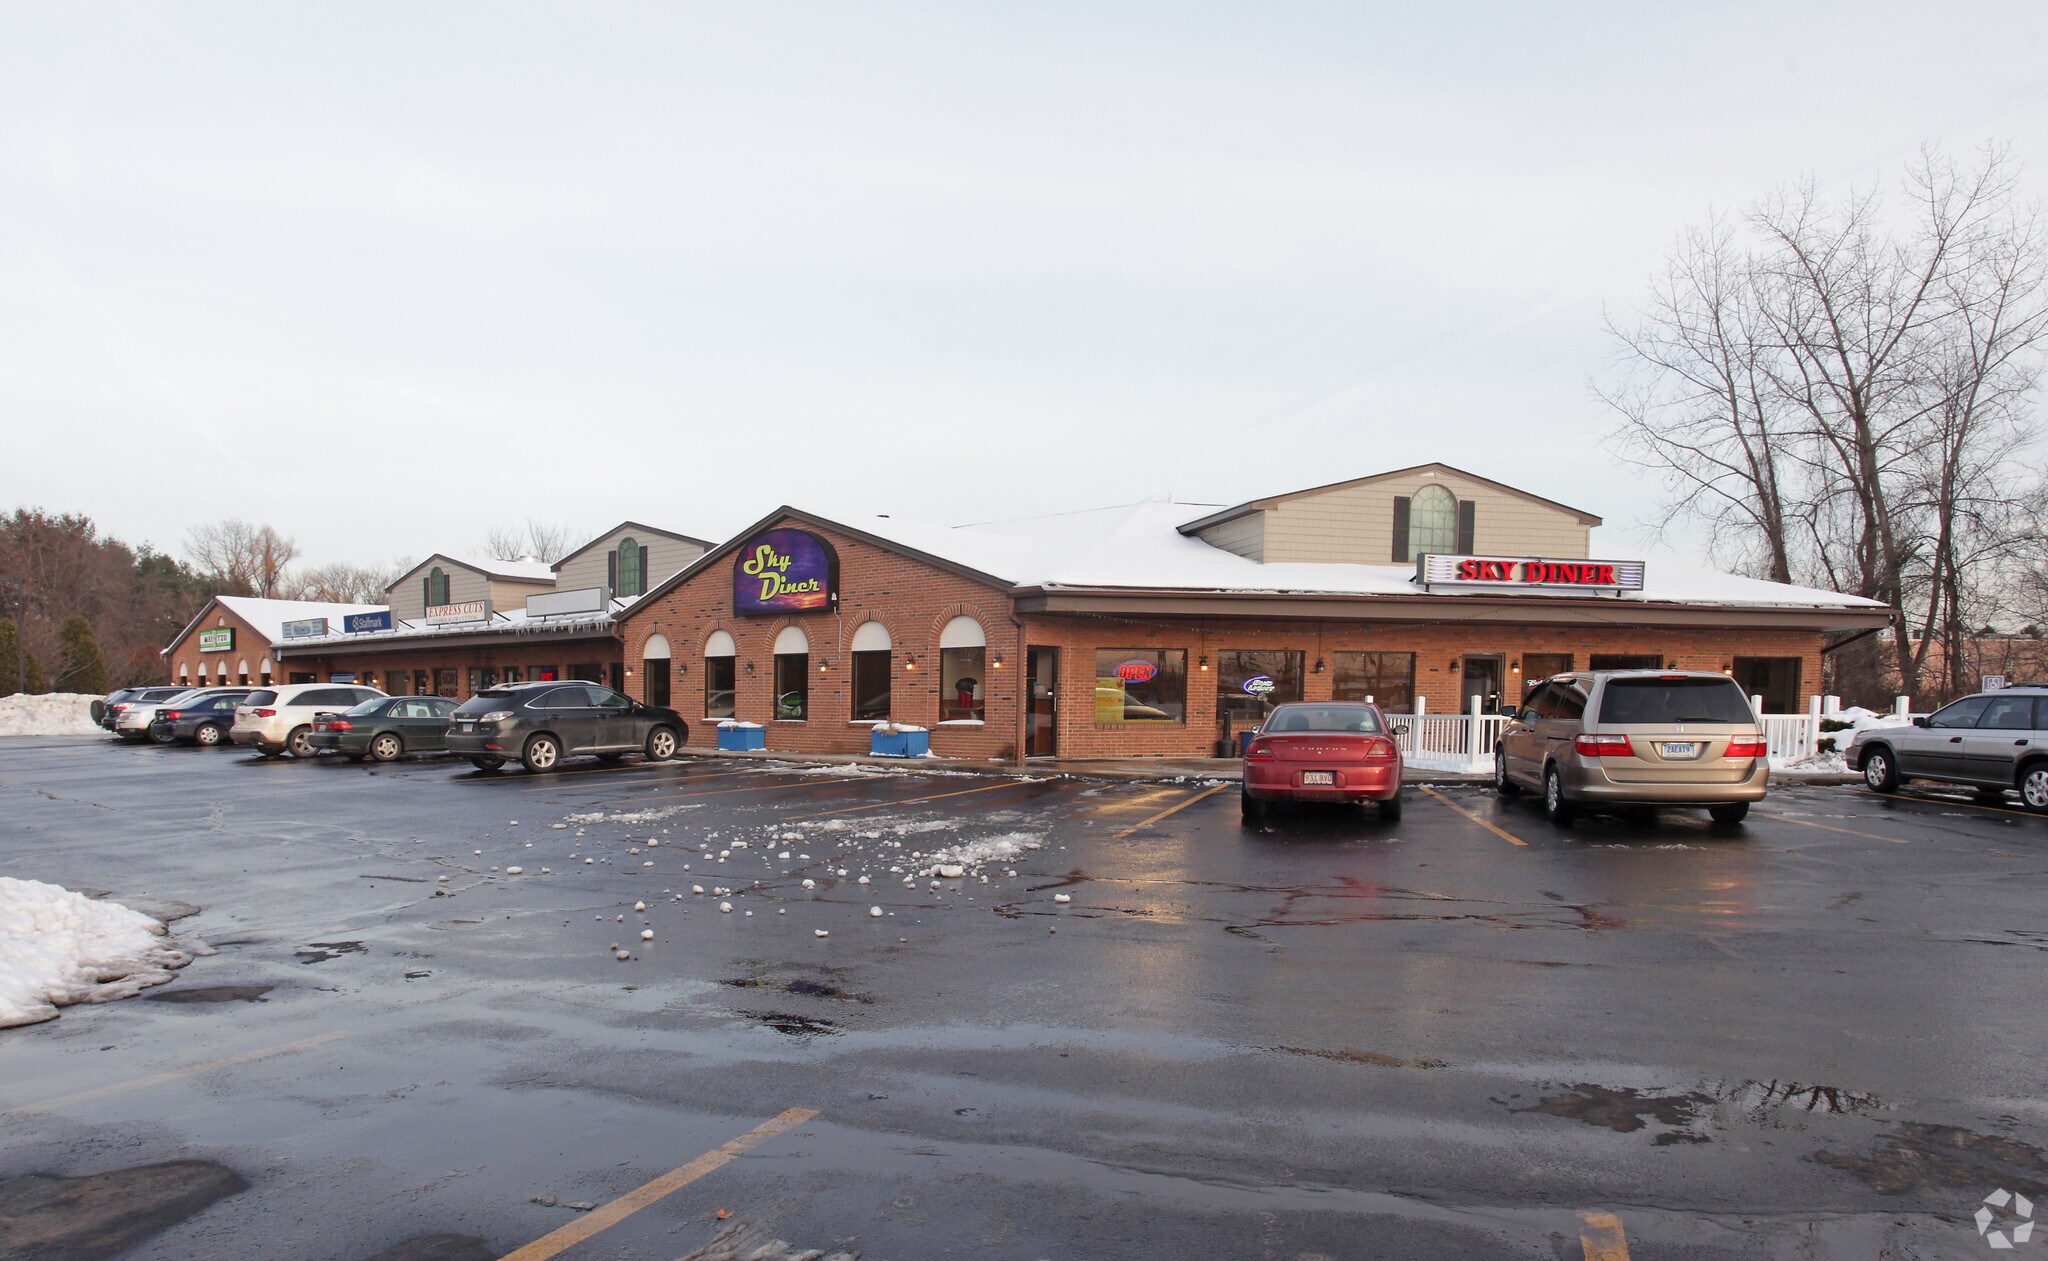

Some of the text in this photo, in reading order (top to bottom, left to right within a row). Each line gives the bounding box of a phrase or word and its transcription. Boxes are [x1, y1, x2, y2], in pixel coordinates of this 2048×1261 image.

[743, 544, 792, 574] Sky
[1458, 559, 1616, 585] SKY DINER
[758, 571, 820, 600] Diner
[429, 601, 483, 618] EXPRESS CUTS
[359, 616, 382, 629] Staffmark
[1117, 664, 1153, 680] OPEN
